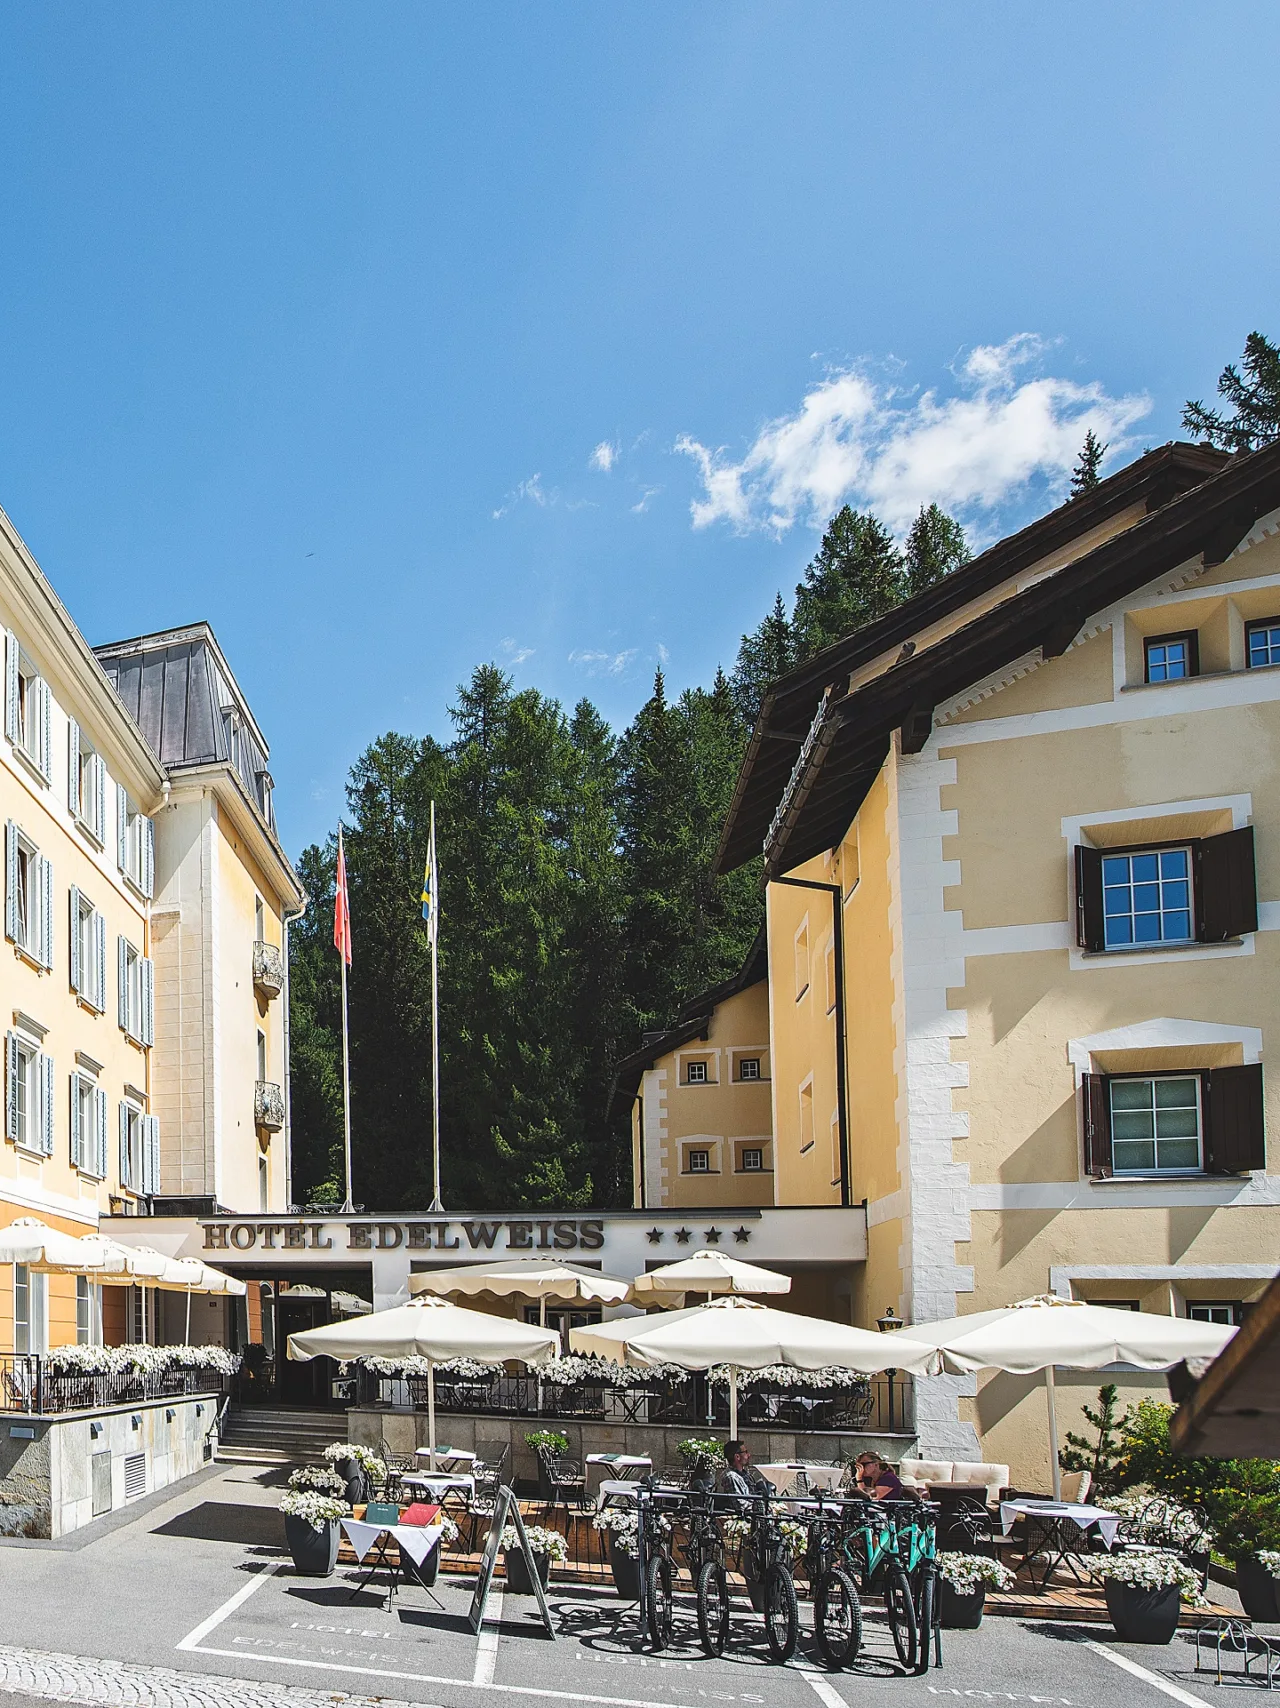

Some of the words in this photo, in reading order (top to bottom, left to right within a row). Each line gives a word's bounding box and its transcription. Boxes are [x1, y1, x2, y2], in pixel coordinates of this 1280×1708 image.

[201, 1222, 333, 1250] HOTEL
[346, 1219, 606, 1250] EDELWEISS
[289, 1622, 402, 1641] HOTEL
[575, 1652, 709, 1671] HOTEL
[927, 1685, 1094, 1708] HOTEL
